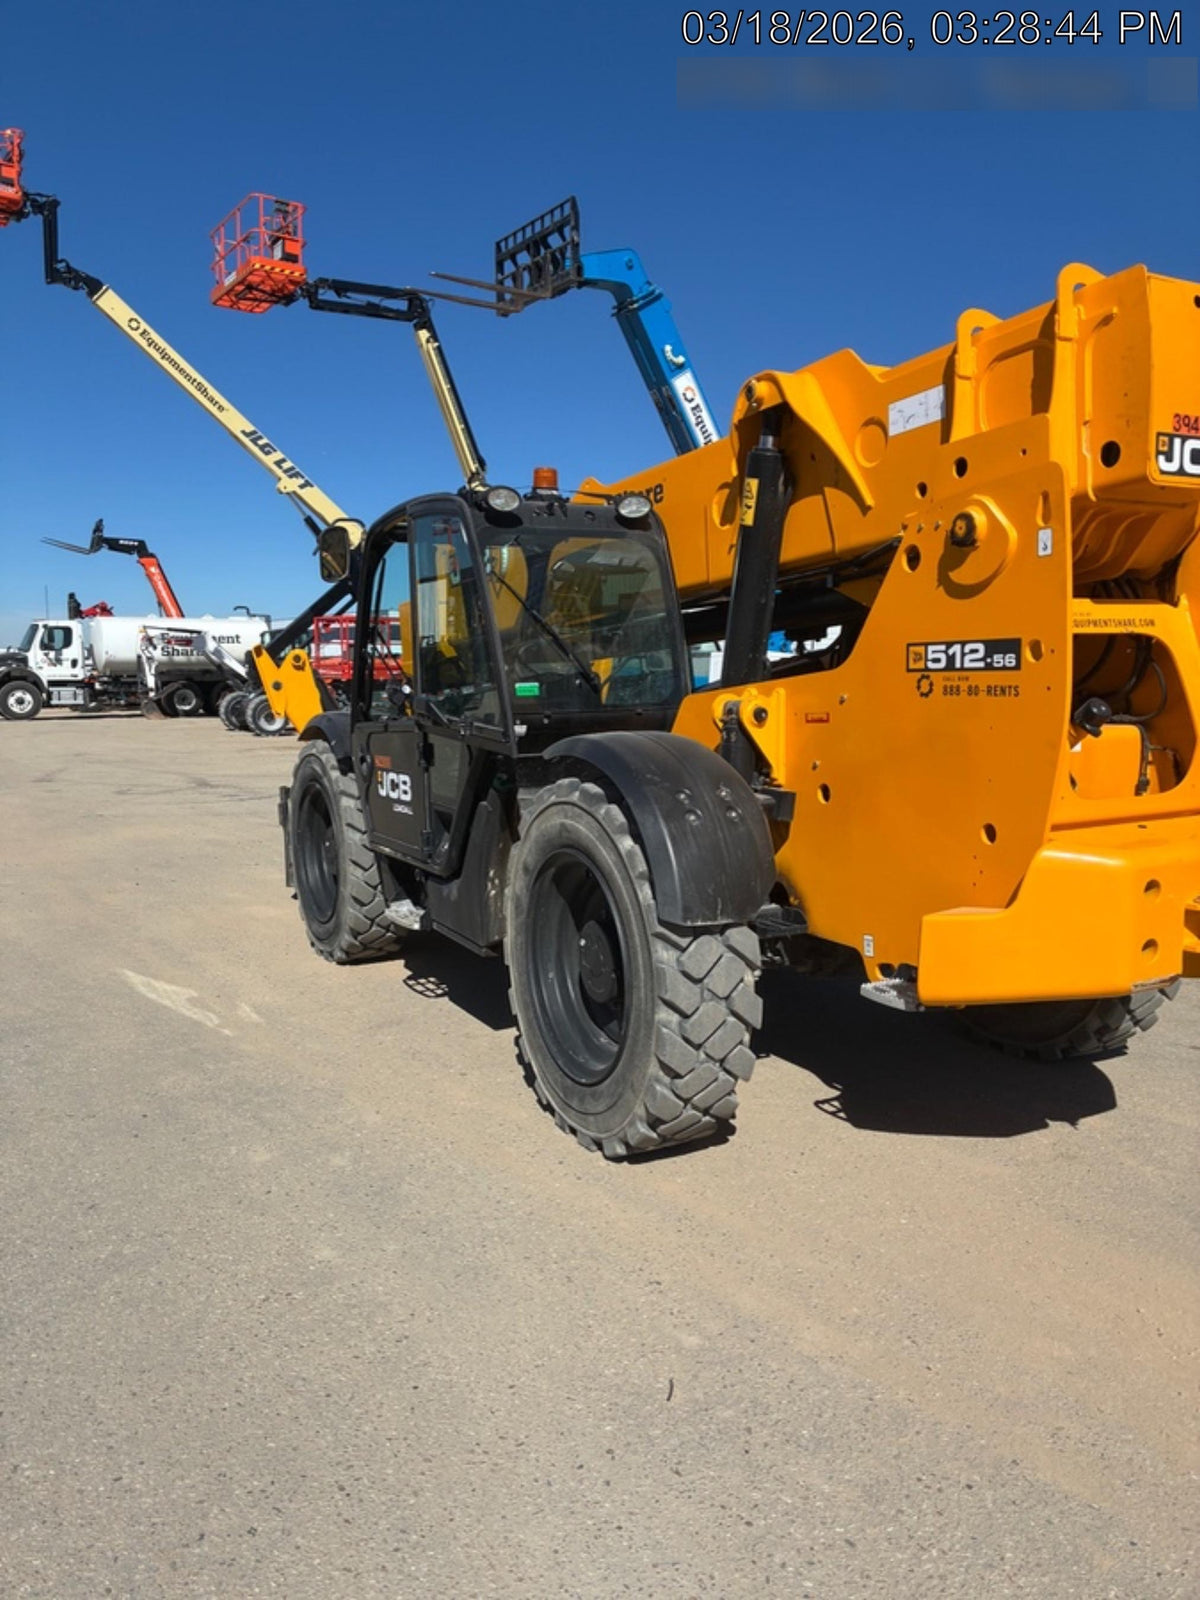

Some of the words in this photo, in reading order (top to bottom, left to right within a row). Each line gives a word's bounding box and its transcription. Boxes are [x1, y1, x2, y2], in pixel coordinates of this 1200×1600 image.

[139, 328, 225, 413] EquipmentShare
[240, 429, 277, 456] JLG
[273, 457, 315, 491] LIFT
[1157, 437, 1200, 474] JC
[1072, 618, 1156, 629] QUIPMENTSHARE.COM
[160, 644, 205, 657] Shar
[942, 684, 1020, 697] 888-80-RENTS
[377, 770, 412, 802] JCB
